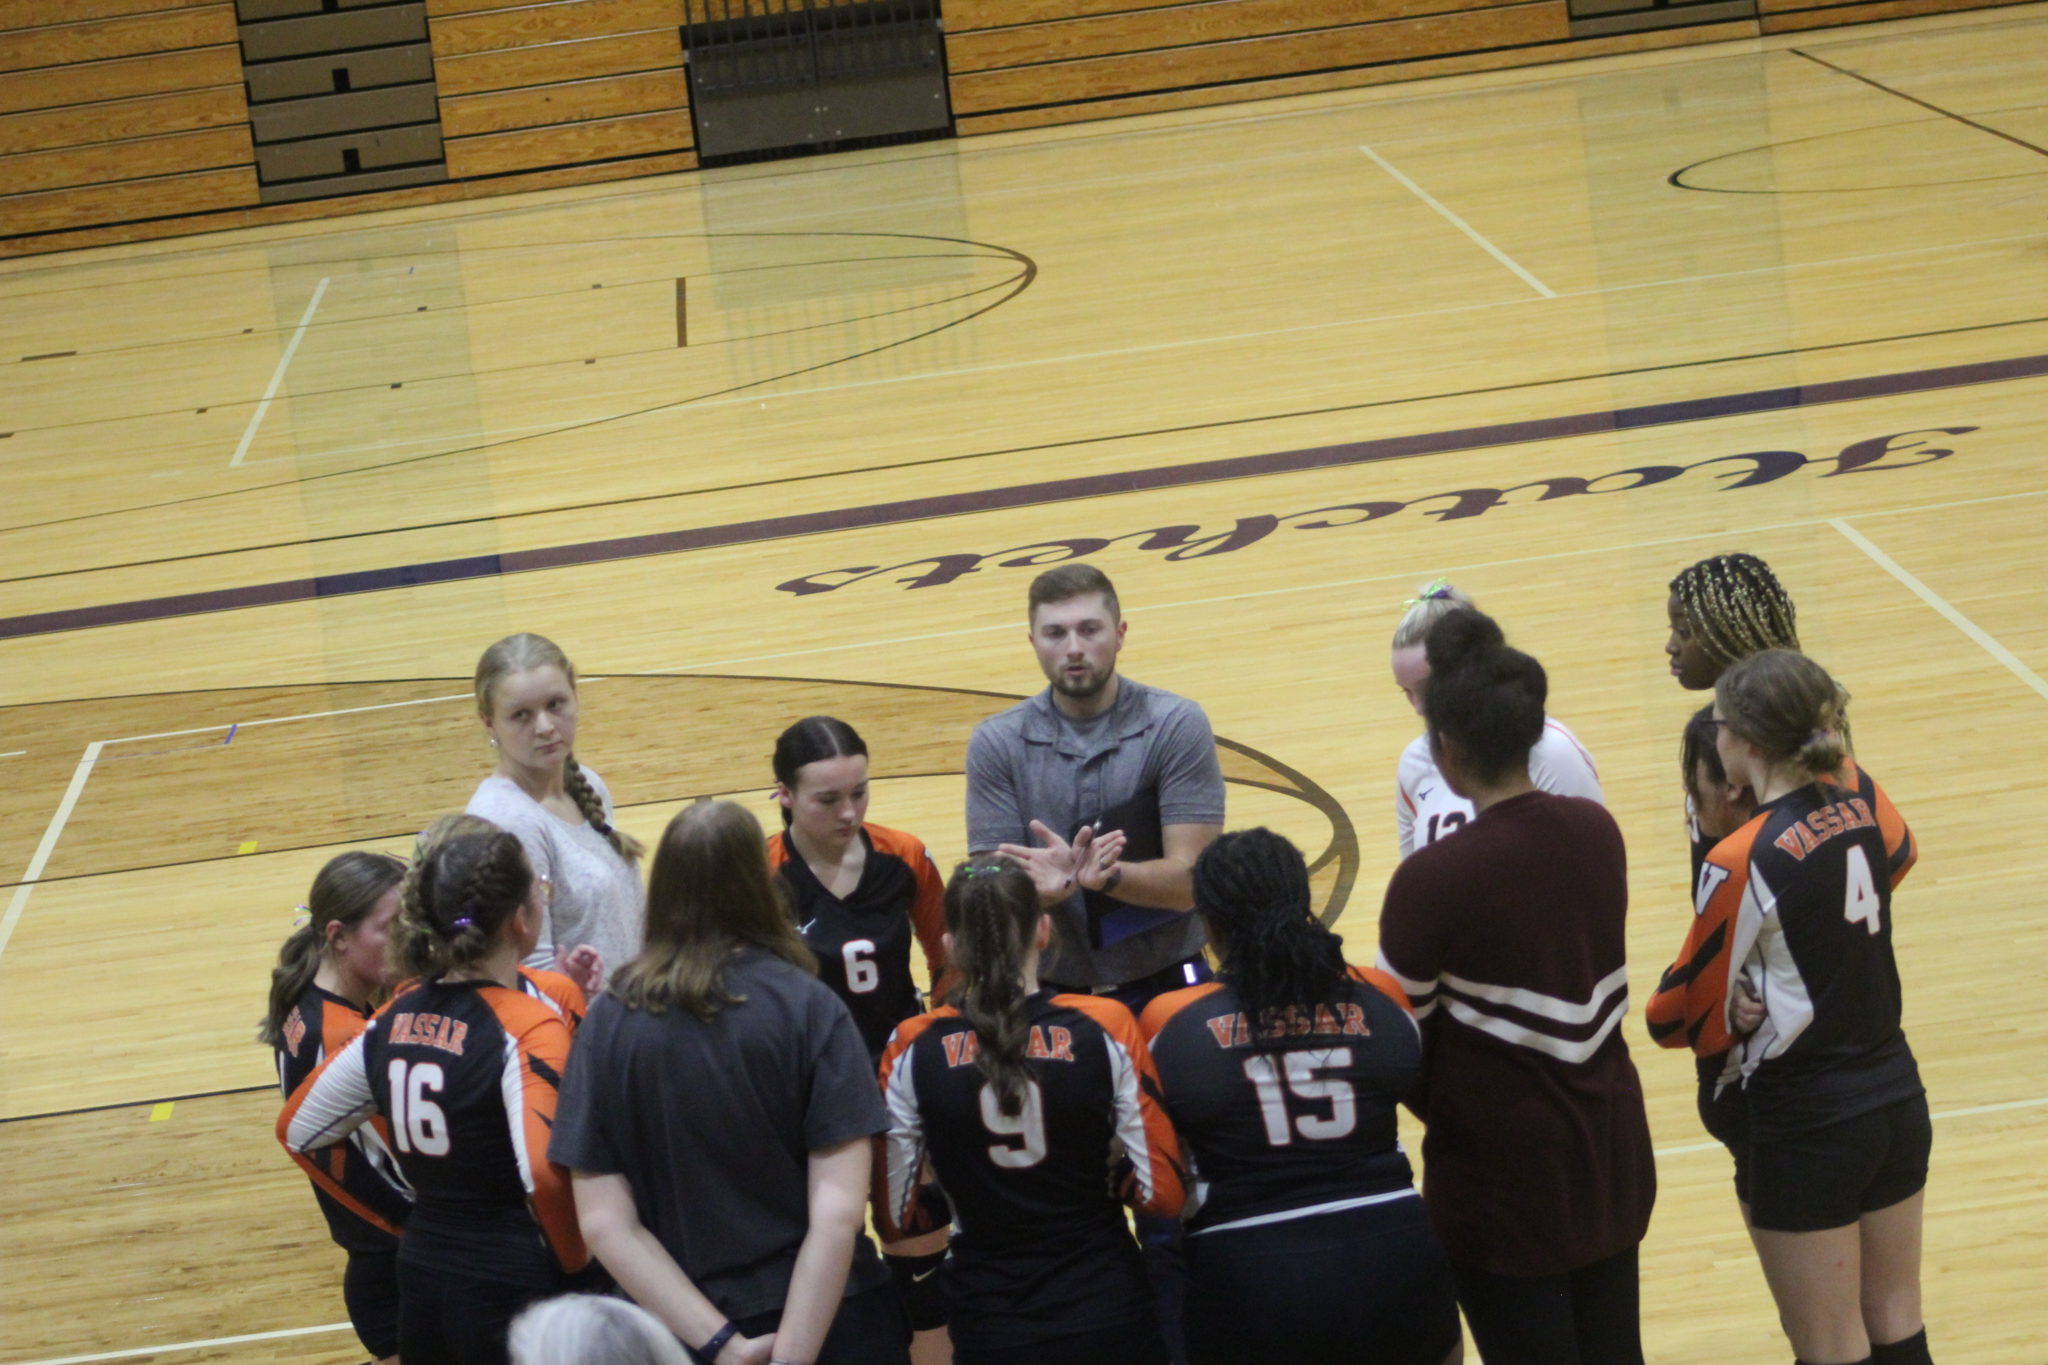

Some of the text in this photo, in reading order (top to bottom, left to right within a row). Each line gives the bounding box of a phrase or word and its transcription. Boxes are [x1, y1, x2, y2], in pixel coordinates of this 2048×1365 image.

[775, 426, 1981, 597] Hatchets
[1773, 798, 1876, 862] VASSAR
[1844, 844, 1881, 935] 4
[841, 938, 879, 993] 6
[388, 1012, 469, 1056] VASSAR
[942, 1025, 1075, 1068] VAAR
[387, 1058, 451, 1157] 16
[979, 1079, 1047, 1169] 9
[1242, 1046, 1357, 1146] 15
